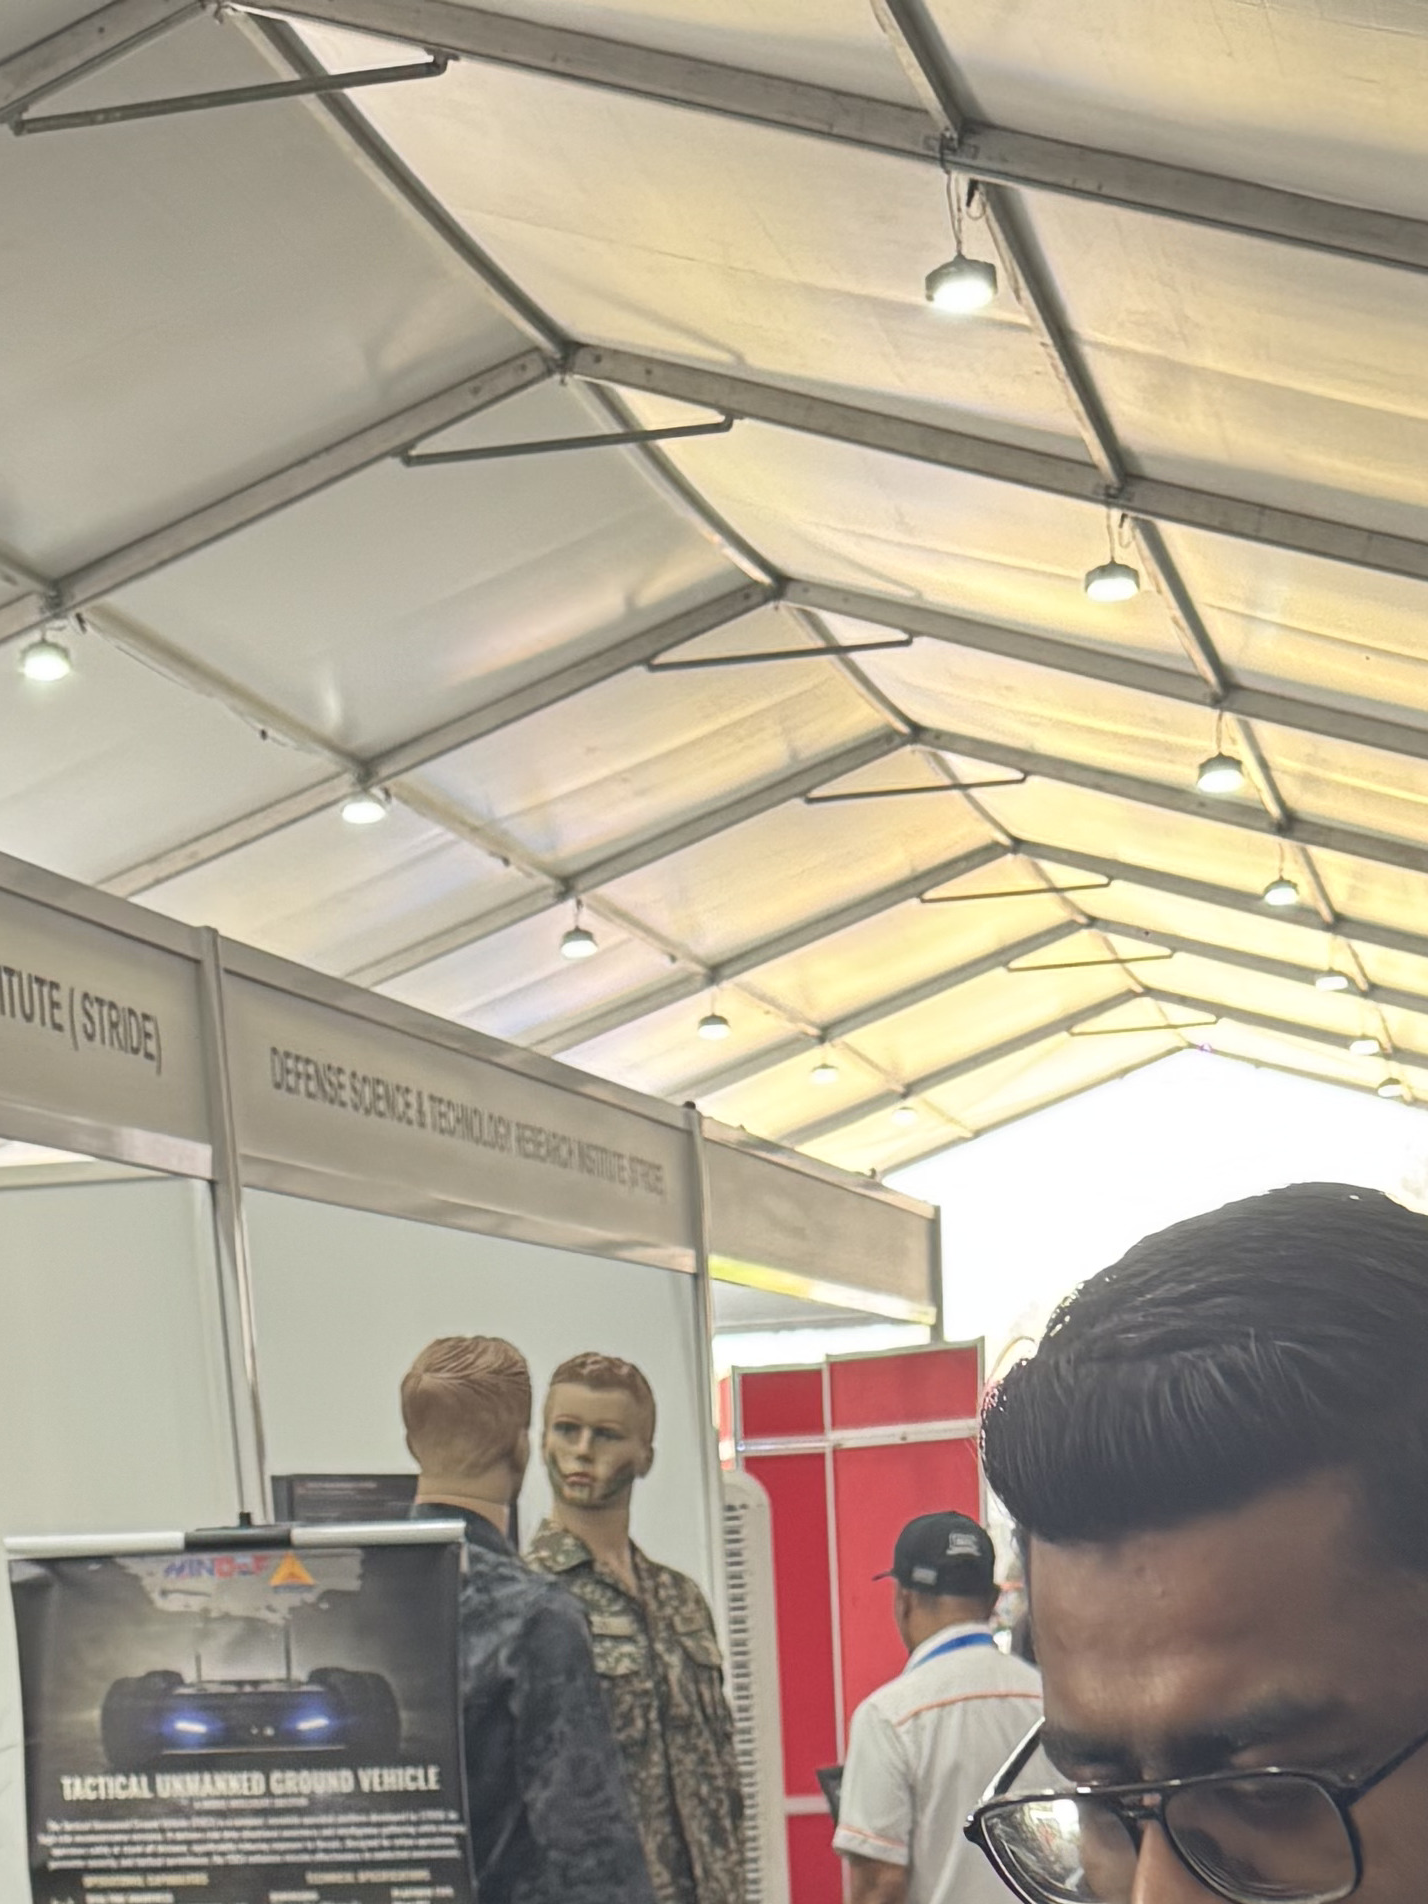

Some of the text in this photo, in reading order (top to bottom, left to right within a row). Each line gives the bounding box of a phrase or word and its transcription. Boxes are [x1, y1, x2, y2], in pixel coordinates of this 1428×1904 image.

[270, 1046, 348, 1109] DEFENSE
[349, 1070, 414, 1126] SCIENCE
[60, 1765, 441, 1801] TACTICAL UNMANNED GROUND VEHICLE
